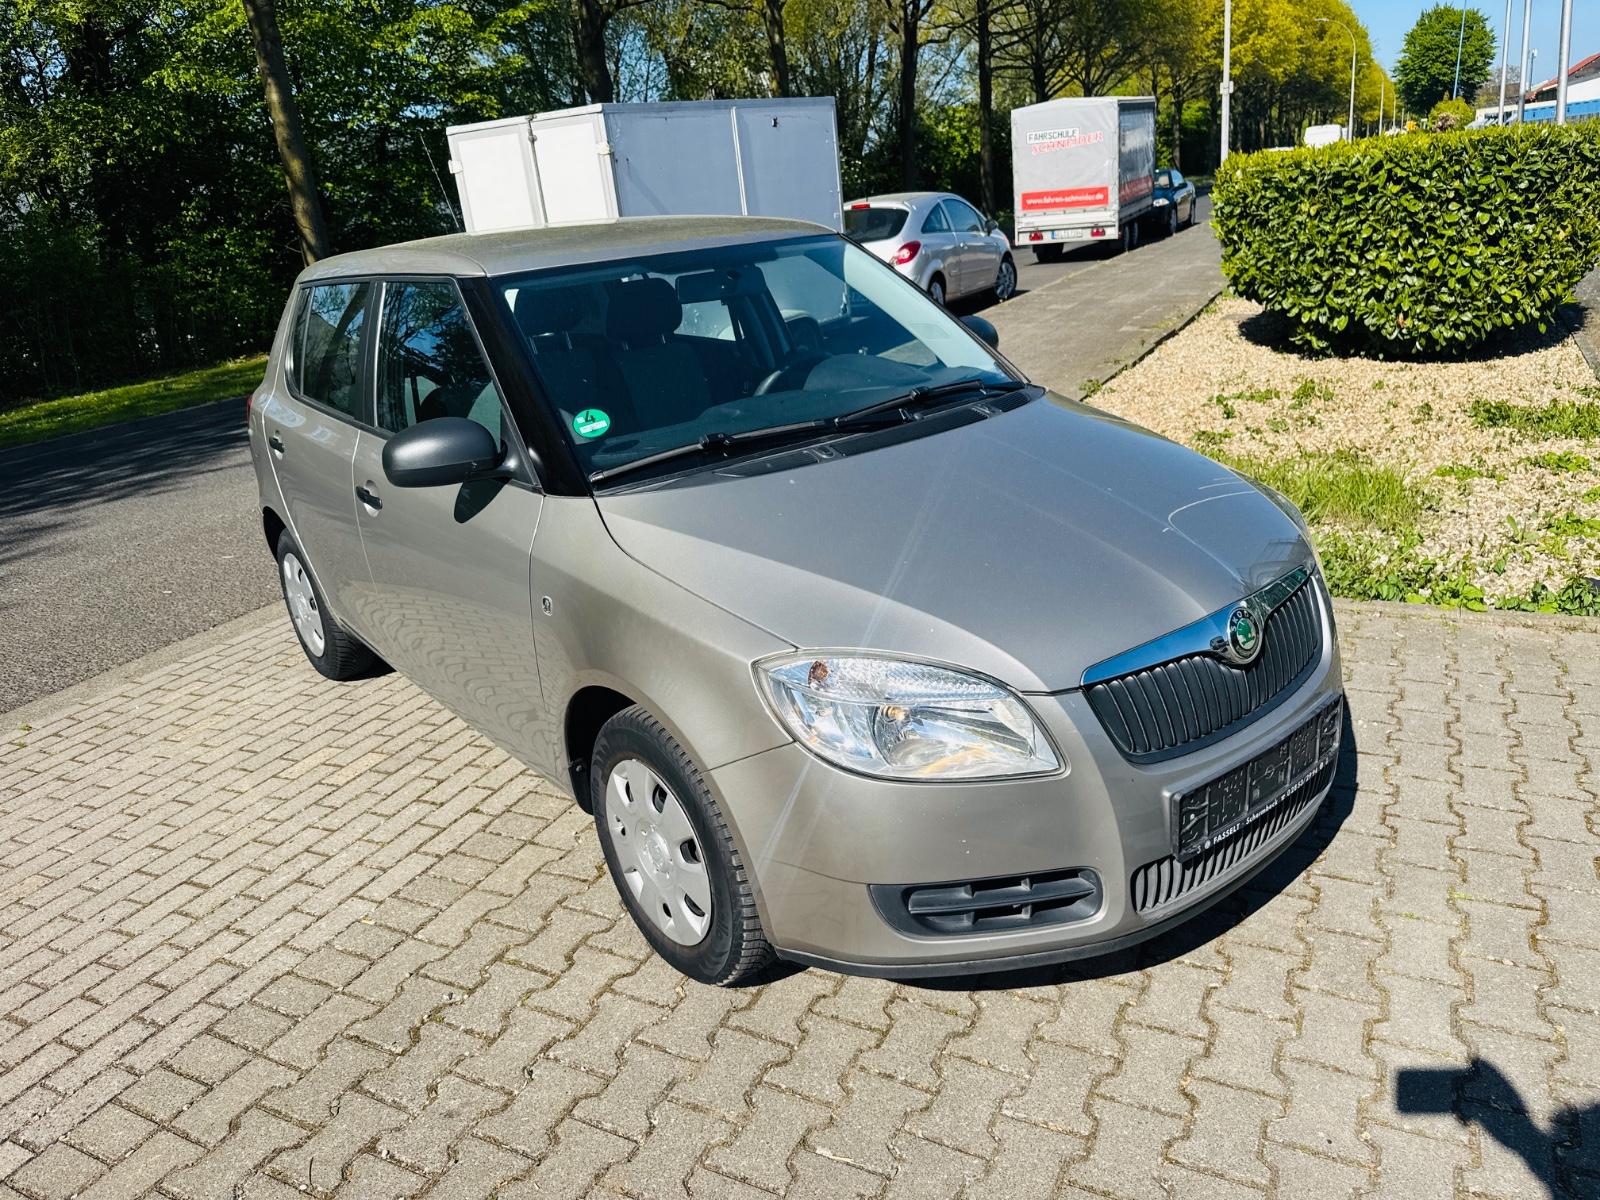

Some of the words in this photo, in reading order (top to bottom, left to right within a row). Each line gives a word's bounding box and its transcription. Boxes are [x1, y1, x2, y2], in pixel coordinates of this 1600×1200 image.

[1028, 129, 1077, 142] FAHRSCHULE
[1026, 192, 1105, 205] www.fahren-schneider.de
[585, 411, 595, 423] 4
[1213, 822, 1241, 845] FASSELT
[1245, 798, 1278, 825] Schermbeck
